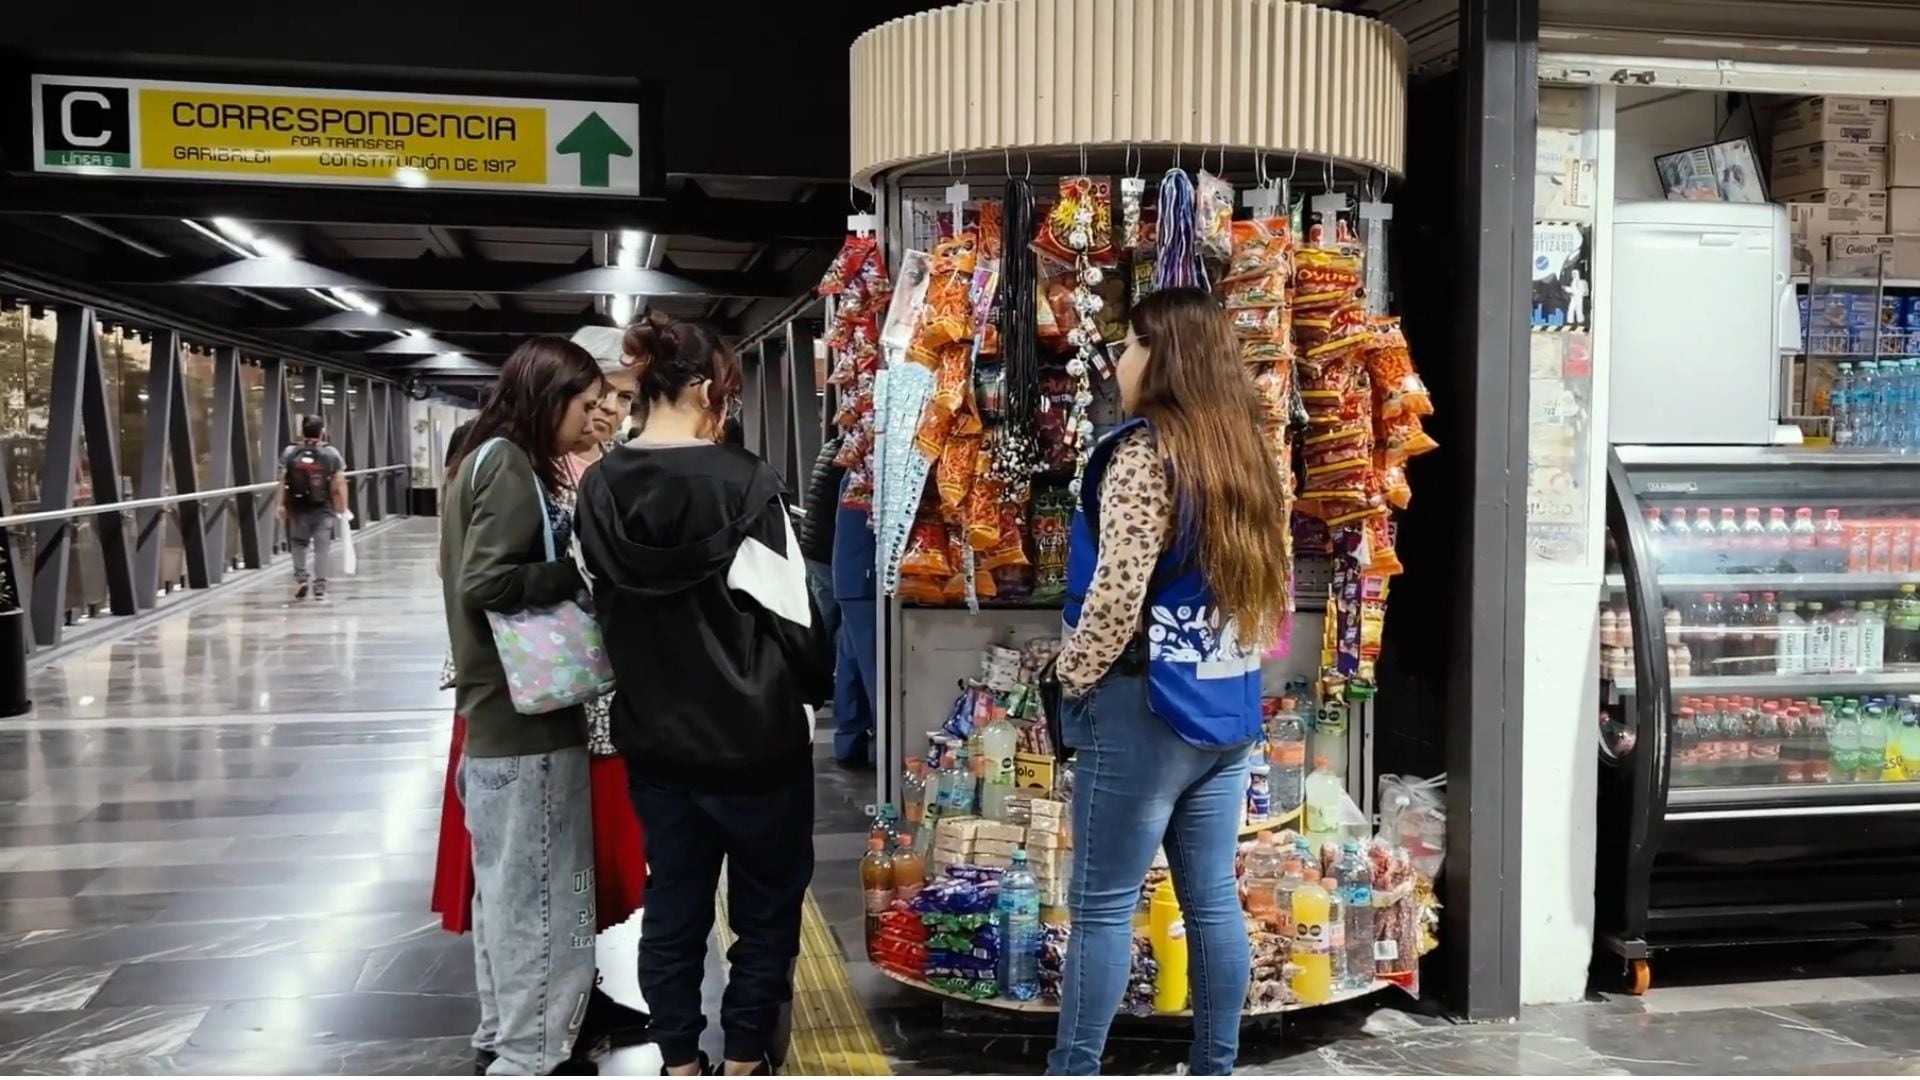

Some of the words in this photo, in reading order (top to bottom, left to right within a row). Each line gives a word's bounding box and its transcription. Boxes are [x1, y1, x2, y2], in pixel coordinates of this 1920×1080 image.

[60, 90, 112, 147] C
[172, 101, 517, 141] CORRESPONDENCIA
[291, 135, 321, 147] FOR
[325, 137, 405, 150] TRANSFER
[173, 145, 271, 164] GARIBALDI
[319, 152, 450, 171] CONSTITUCIÓN
[454, 157, 478, 171] DE
[483, 159, 517, 173] 1917
